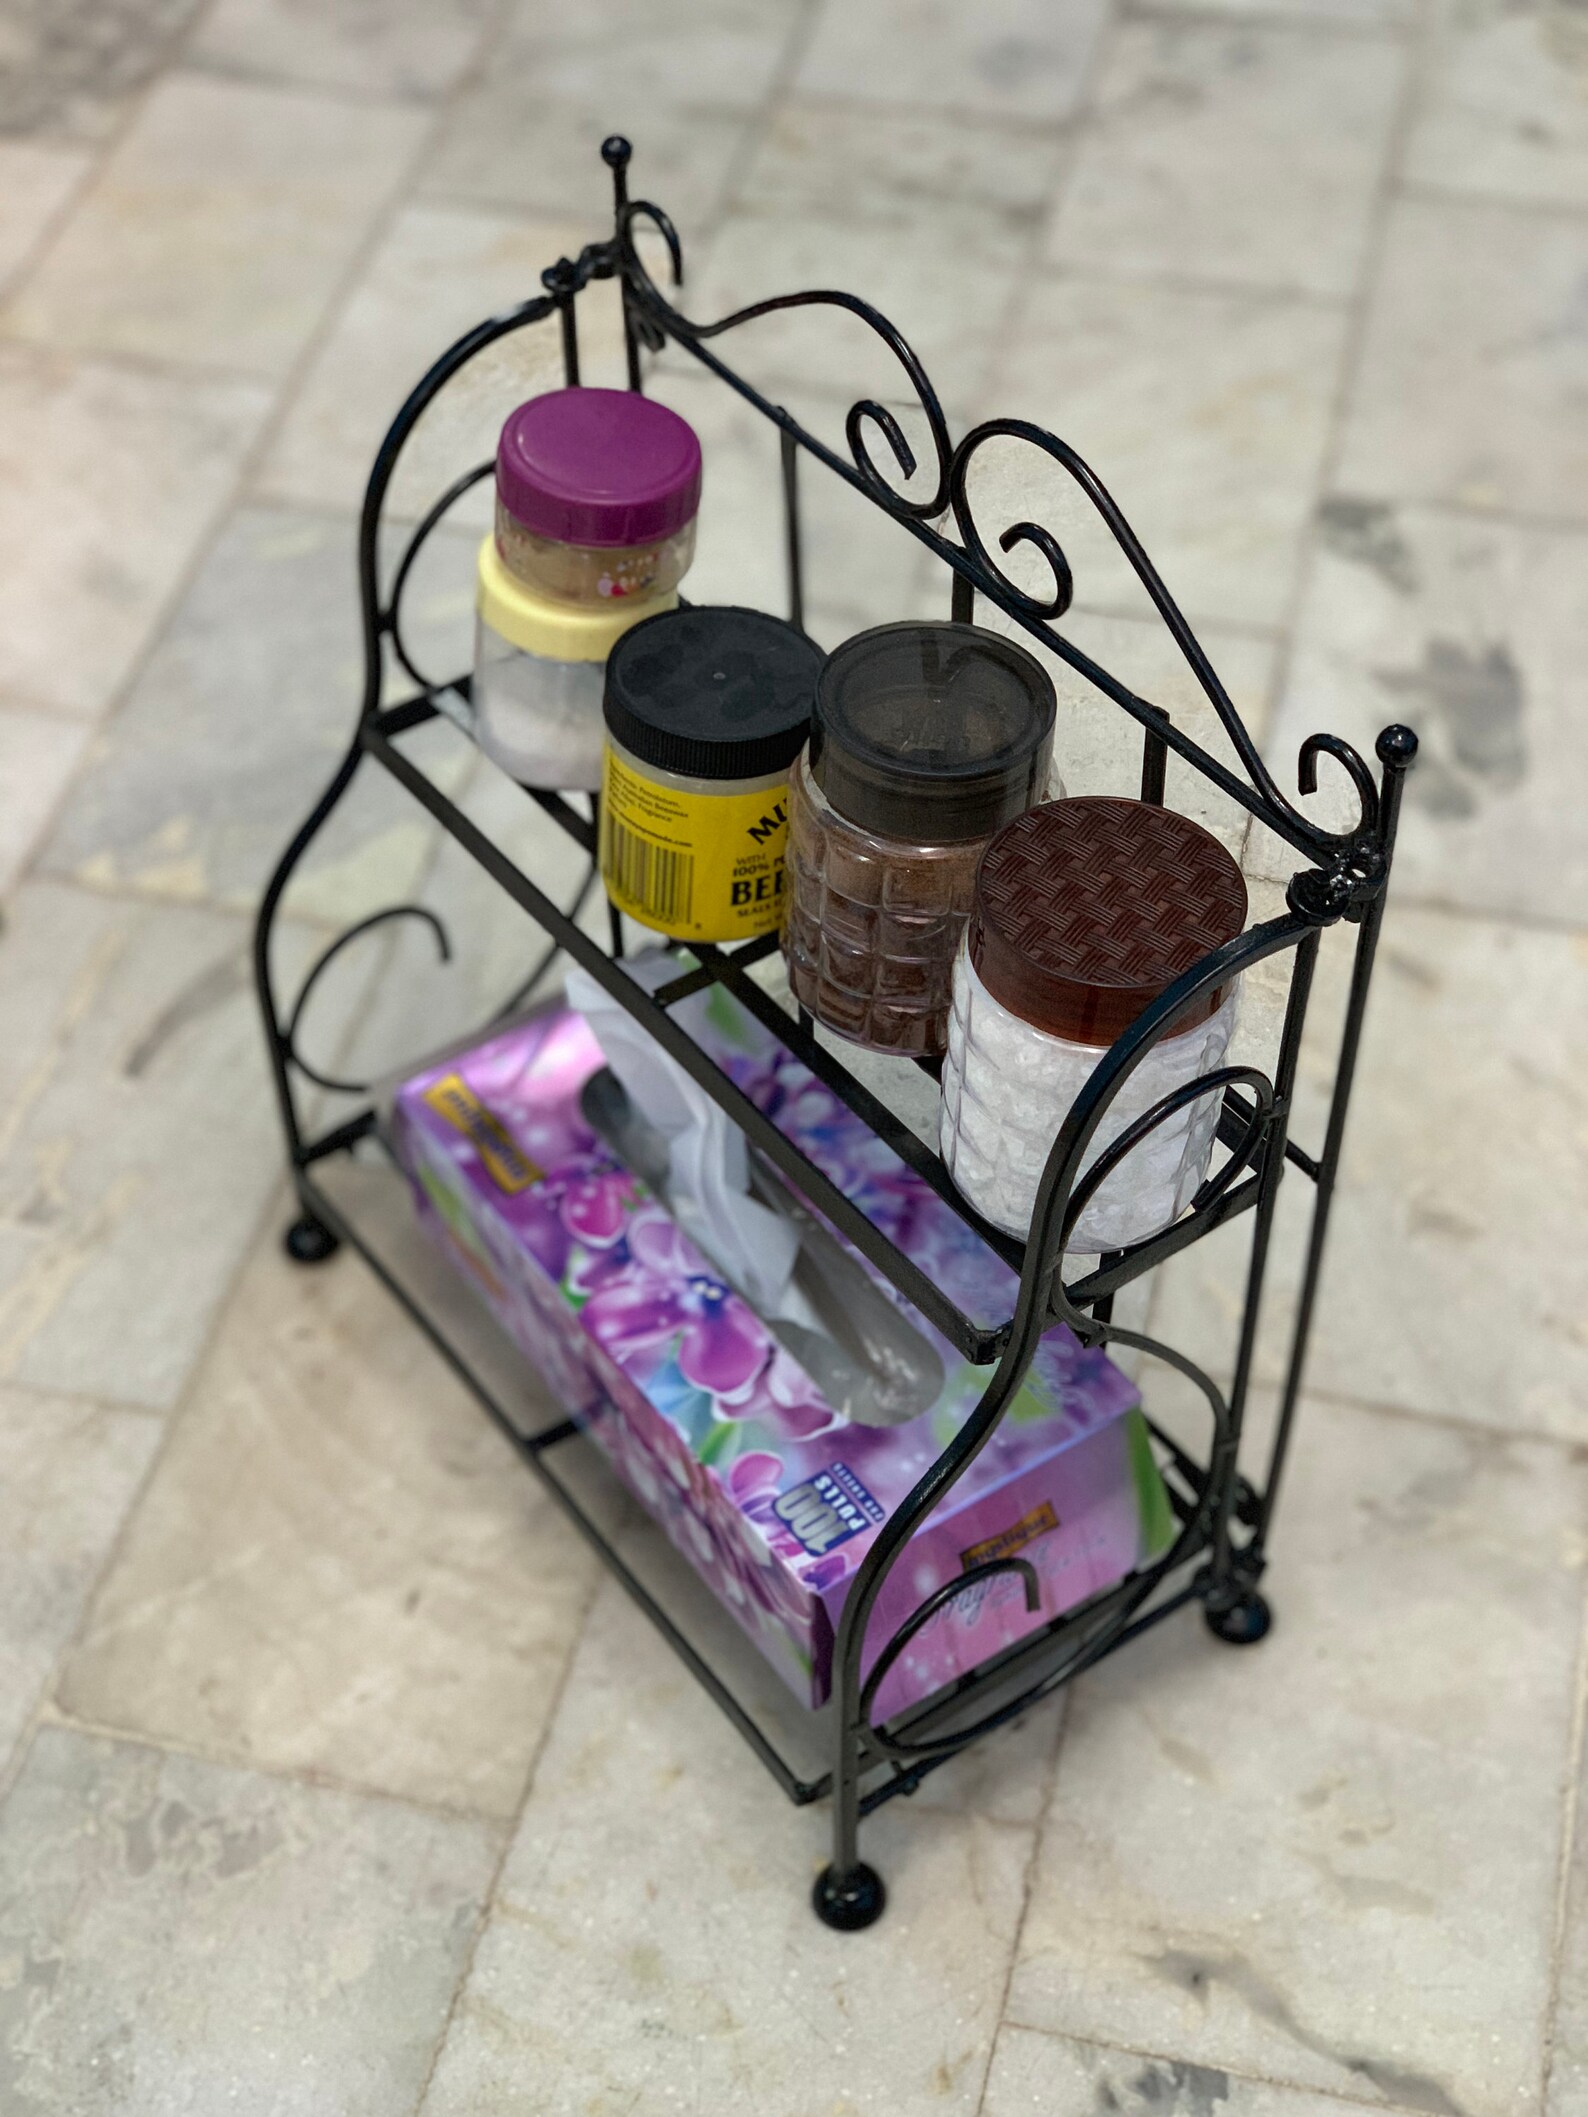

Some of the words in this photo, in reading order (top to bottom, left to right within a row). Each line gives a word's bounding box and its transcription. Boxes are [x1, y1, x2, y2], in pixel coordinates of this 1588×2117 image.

[733, 862, 770, 877] 100%
[777, 1482, 848, 1554] 100
[813, 1474, 867, 1531] PULLS
